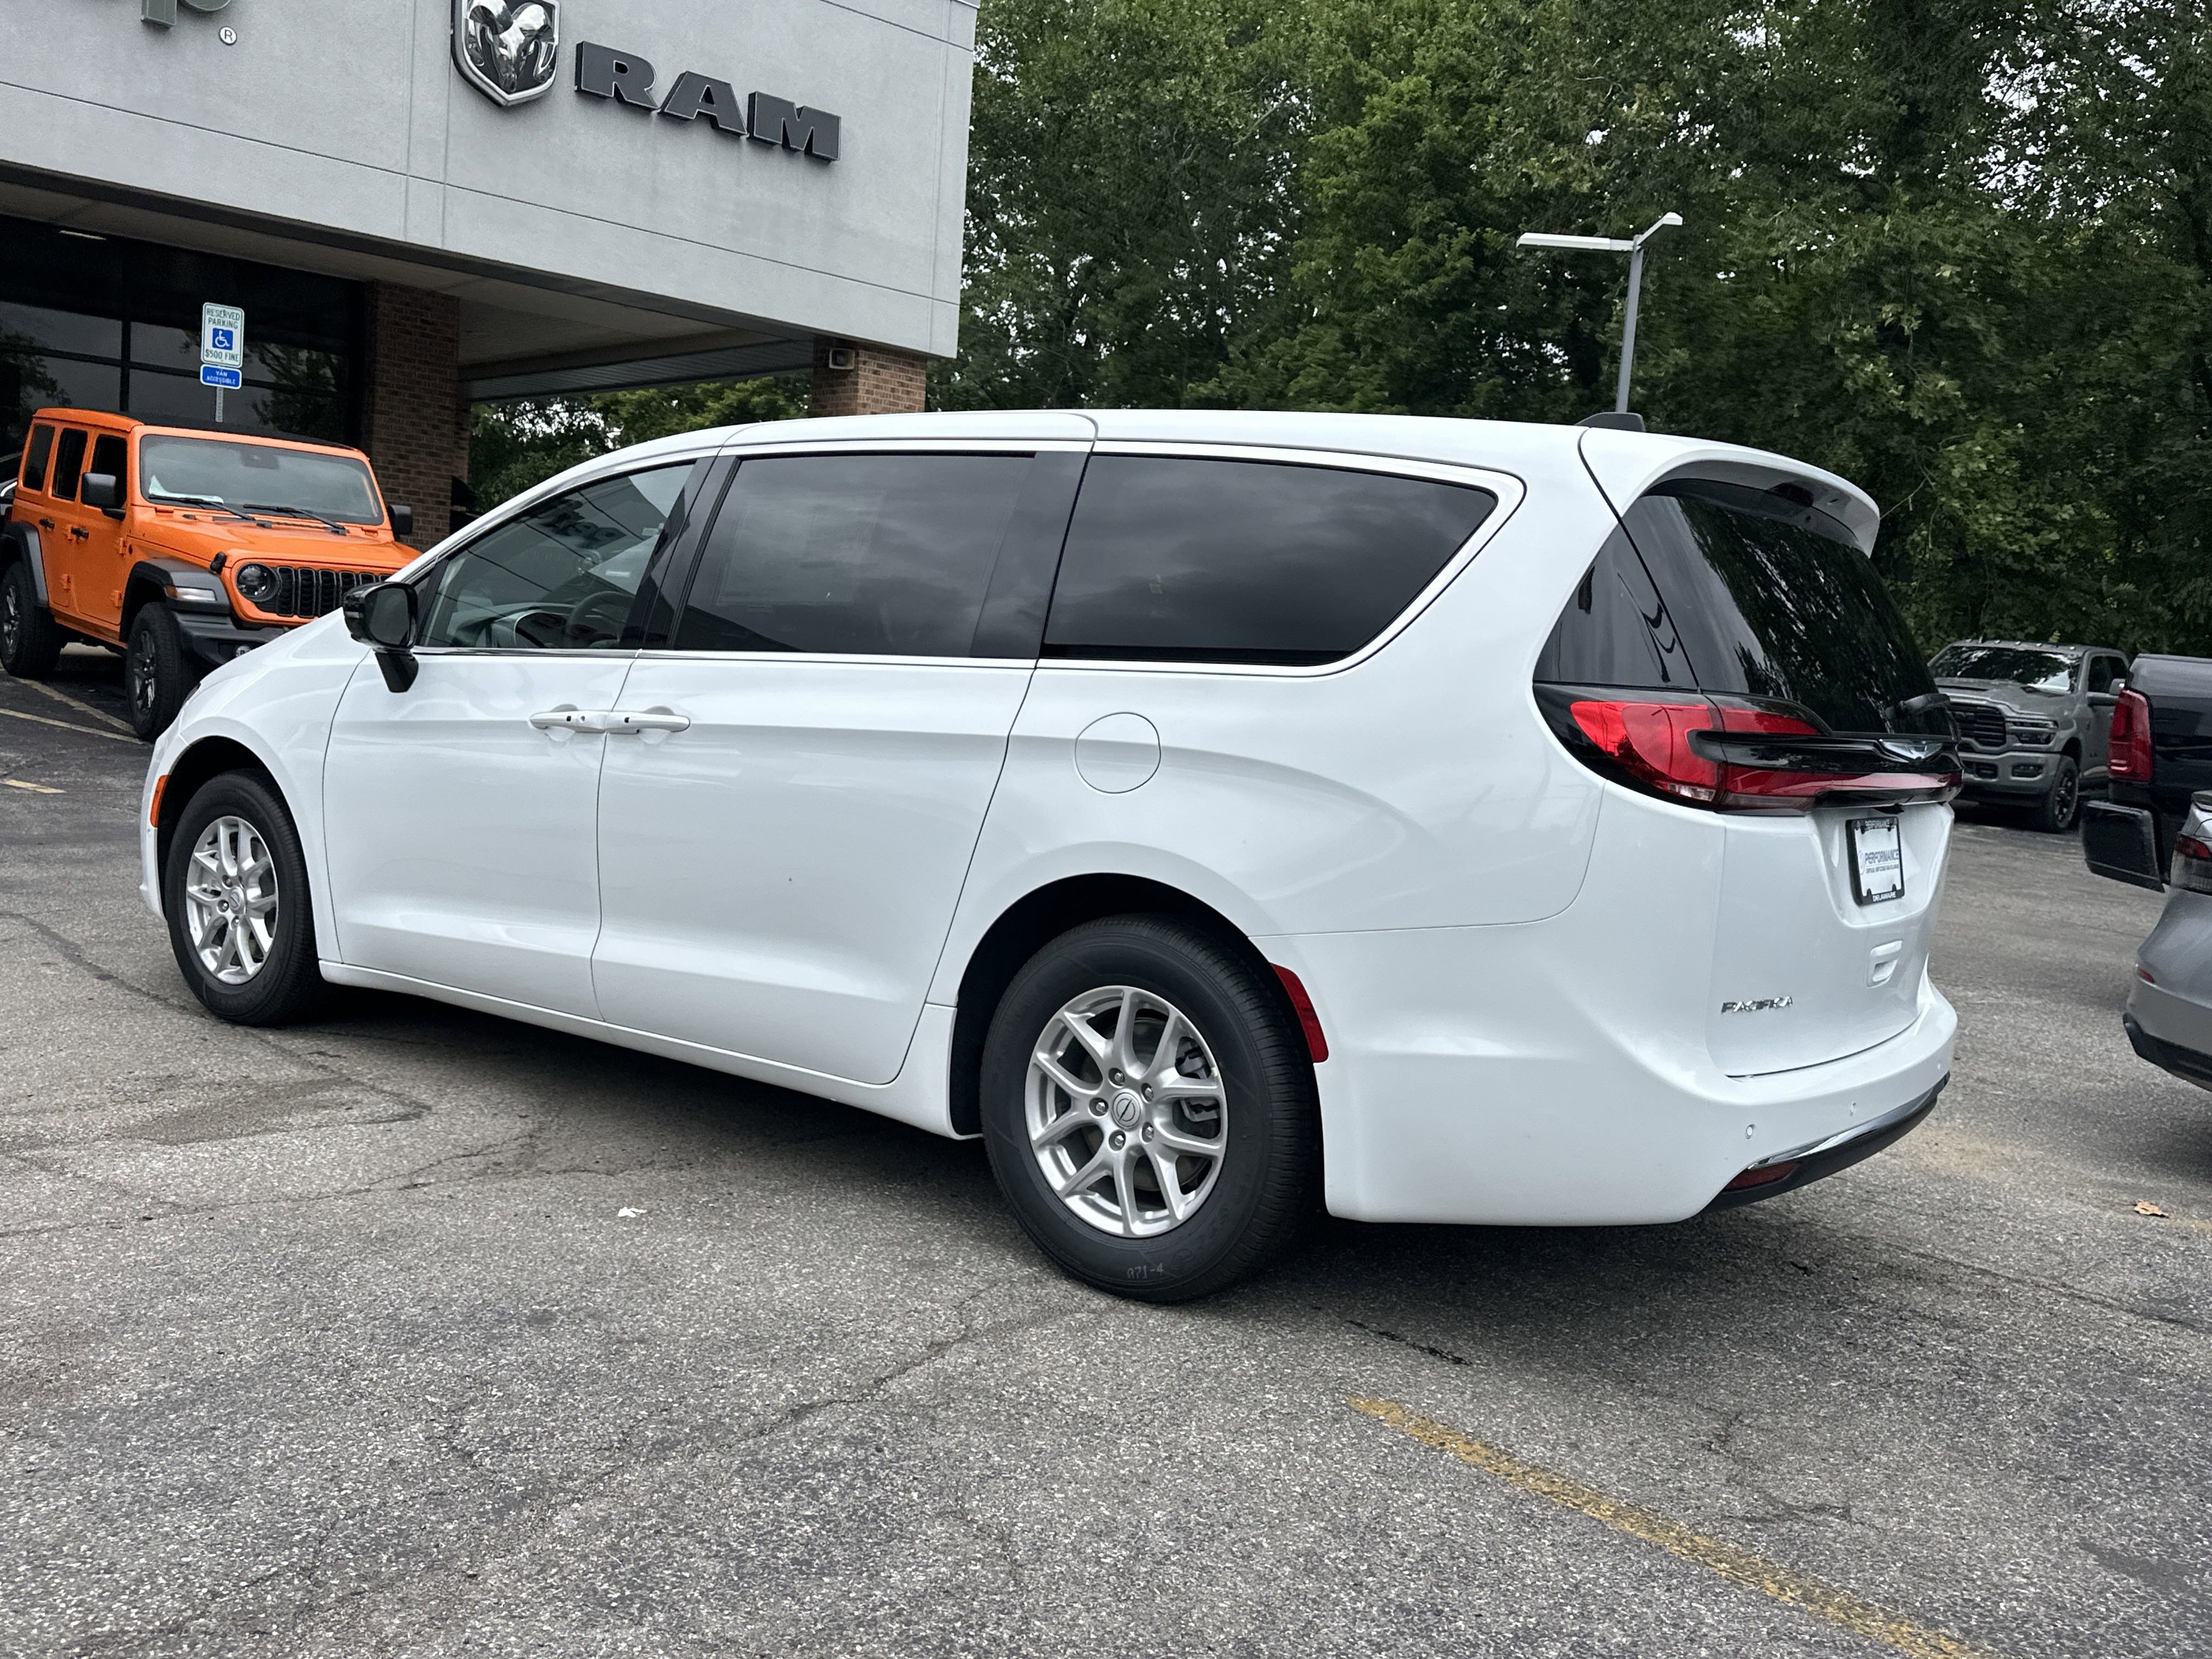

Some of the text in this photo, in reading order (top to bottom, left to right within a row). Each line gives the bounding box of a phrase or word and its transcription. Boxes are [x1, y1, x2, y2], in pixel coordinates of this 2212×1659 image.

[575, 41, 842, 160] RAM
[206, 308, 240, 320] RESERVED
[208, 317, 238, 329] PARKING
[205, 349, 239, 362] $500 FINE
[1721, 996, 1793, 1013] PACIFICA
